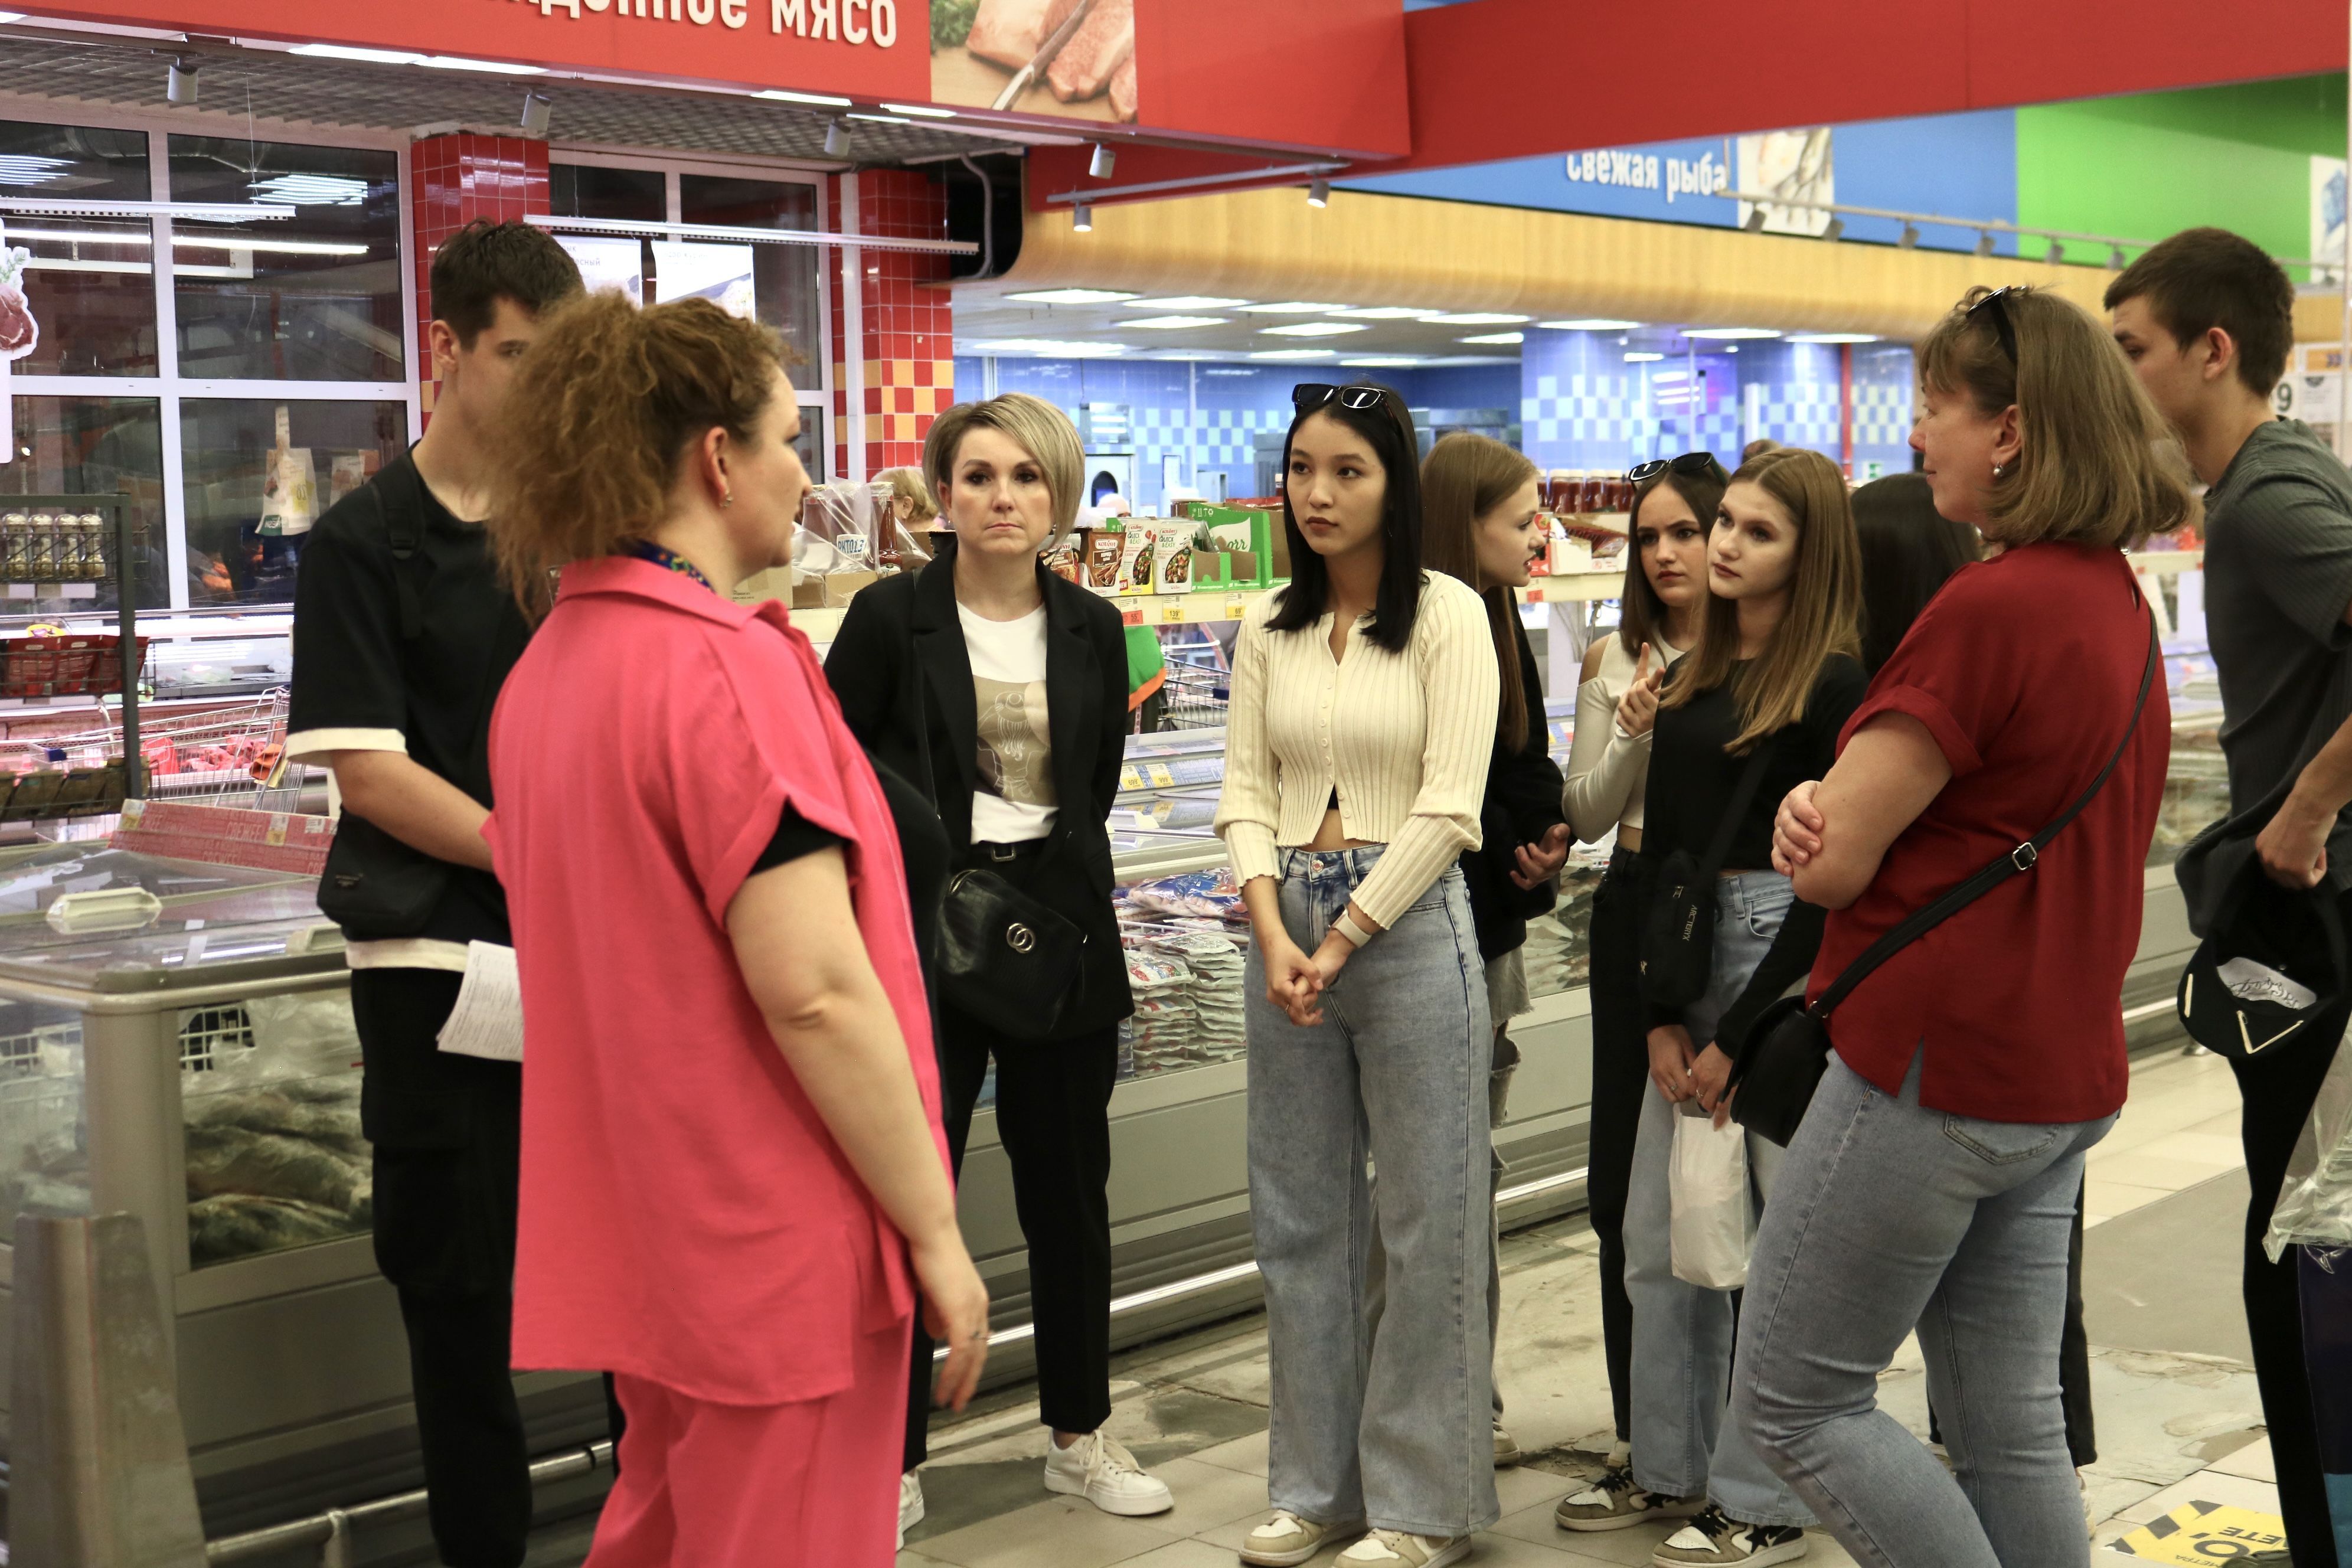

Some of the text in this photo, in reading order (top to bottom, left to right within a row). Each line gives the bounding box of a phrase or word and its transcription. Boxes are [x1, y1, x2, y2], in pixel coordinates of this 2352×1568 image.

[772, 0, 897, 48] мясо
[1665, 151, 1727, 204] рыба
[1227, 538, 1248, 550] orr
